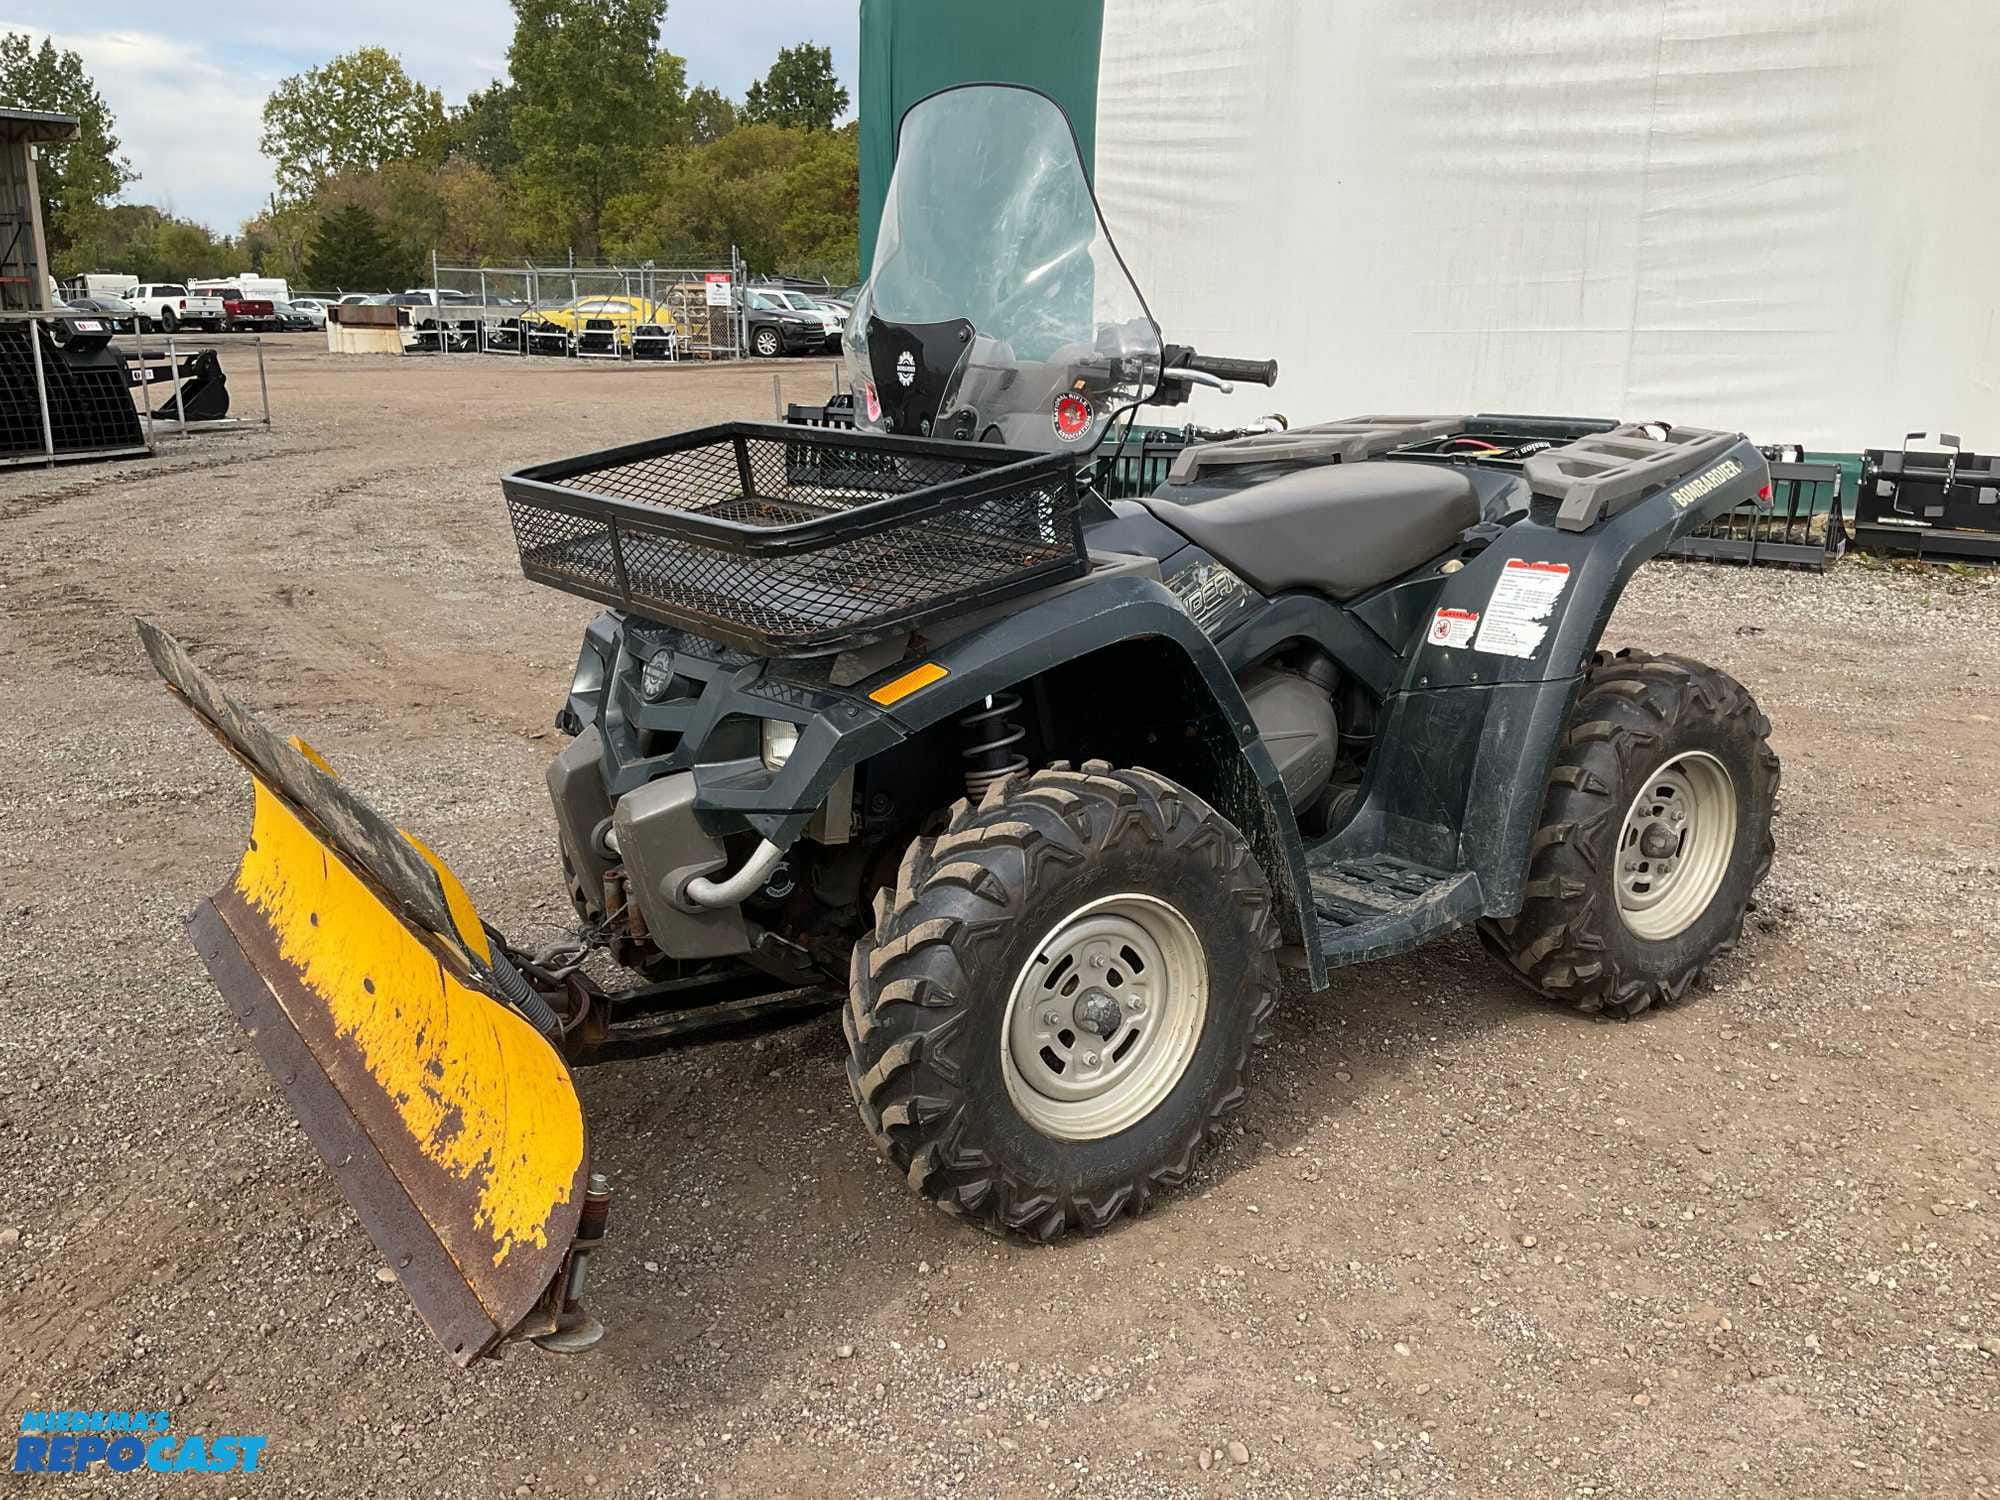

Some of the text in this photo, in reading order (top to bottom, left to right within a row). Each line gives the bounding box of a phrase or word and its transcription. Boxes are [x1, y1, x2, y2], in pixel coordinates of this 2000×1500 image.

[1054, 393, 1068, 423] NATIONAL
[1058, 415, 1093, 440] ASSOCIATION
[1671, 460, 1742, 508] BOMBARDIER
